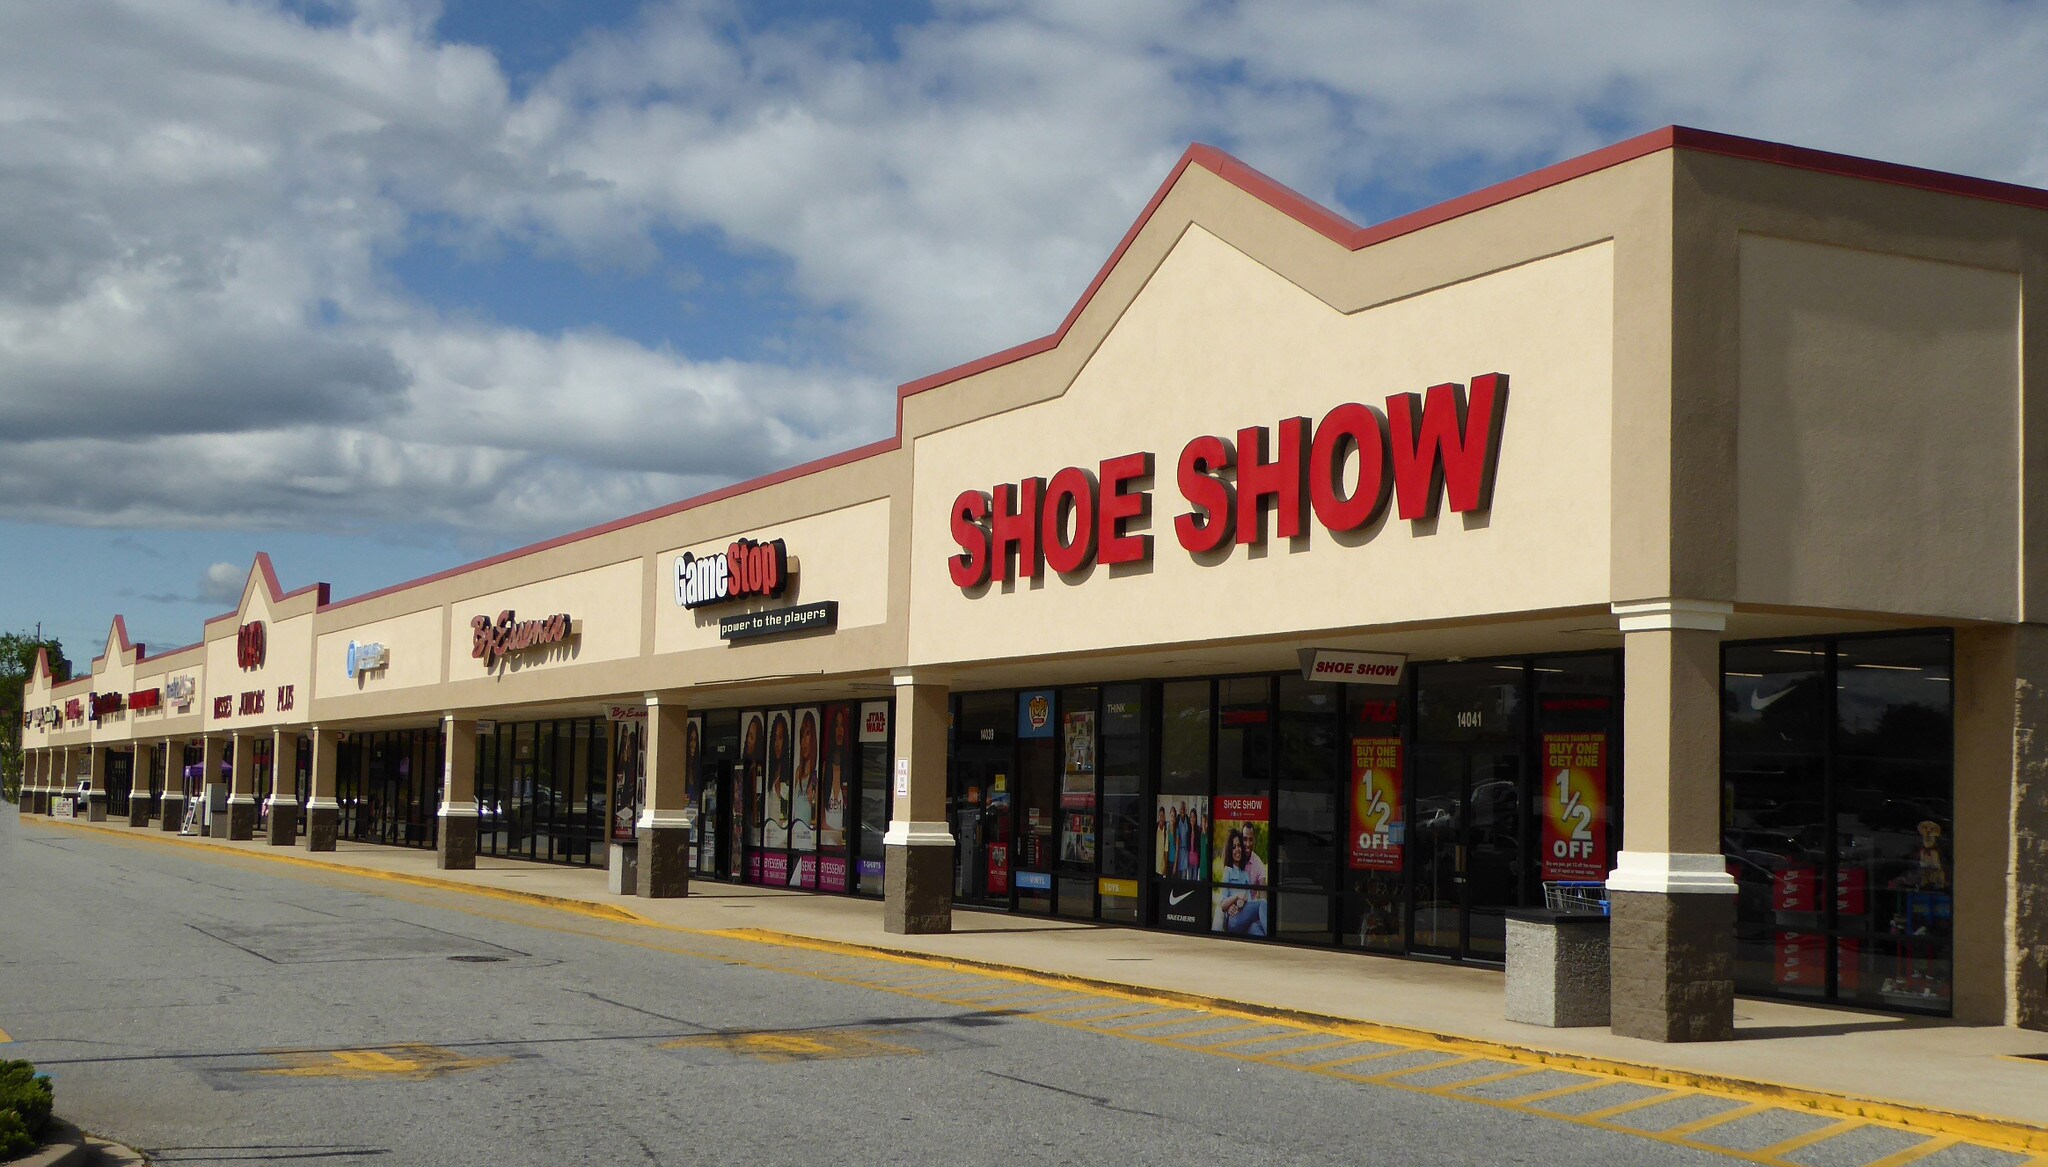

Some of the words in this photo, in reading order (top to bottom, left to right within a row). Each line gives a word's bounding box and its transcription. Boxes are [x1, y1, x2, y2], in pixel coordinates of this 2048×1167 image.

[948, 452, 1153, 589] SHOE
[1174, 372, 1508, 553] SHOW
[674, 540, 783, 607] GameStop
[721, 620, 750, 636] power
[752, 617, 763, 628] to
[765, 615, 782, 626] the
[784, 608, 826, 625] players
[1316, 662, 1354, 674] SHOE
[1356, 664, 1399, 676] SHOW
[1107, 703, 1126, 714] THINK
[866, 712, 885, 722] STAR
[1457, 711, 1482, 728] 14041
[866, 722, 886, 733] WARS
[1357, 746, 1375, 756] BUY
[1376, 746, 1396, 756] ONE
[1549, 743, 1573, 754] BUY
[1576, 743, 1599, 754] ONE
[1357, 757, 1374, 768] GET
[1376, 757, 1396, 768] ONE
[1549, 755, 1573, 767] GET
[1575, 755, 1598, 767] ONE
[1223, 799, 1241, 809] SHOE
[1242, 799, 1262, 810] SHOW
[1553, 840, 1593, 859] OFF
[1104, 882, 1120, 893] TOYS
[1166, 914, 1196, 923] SKECHERS
